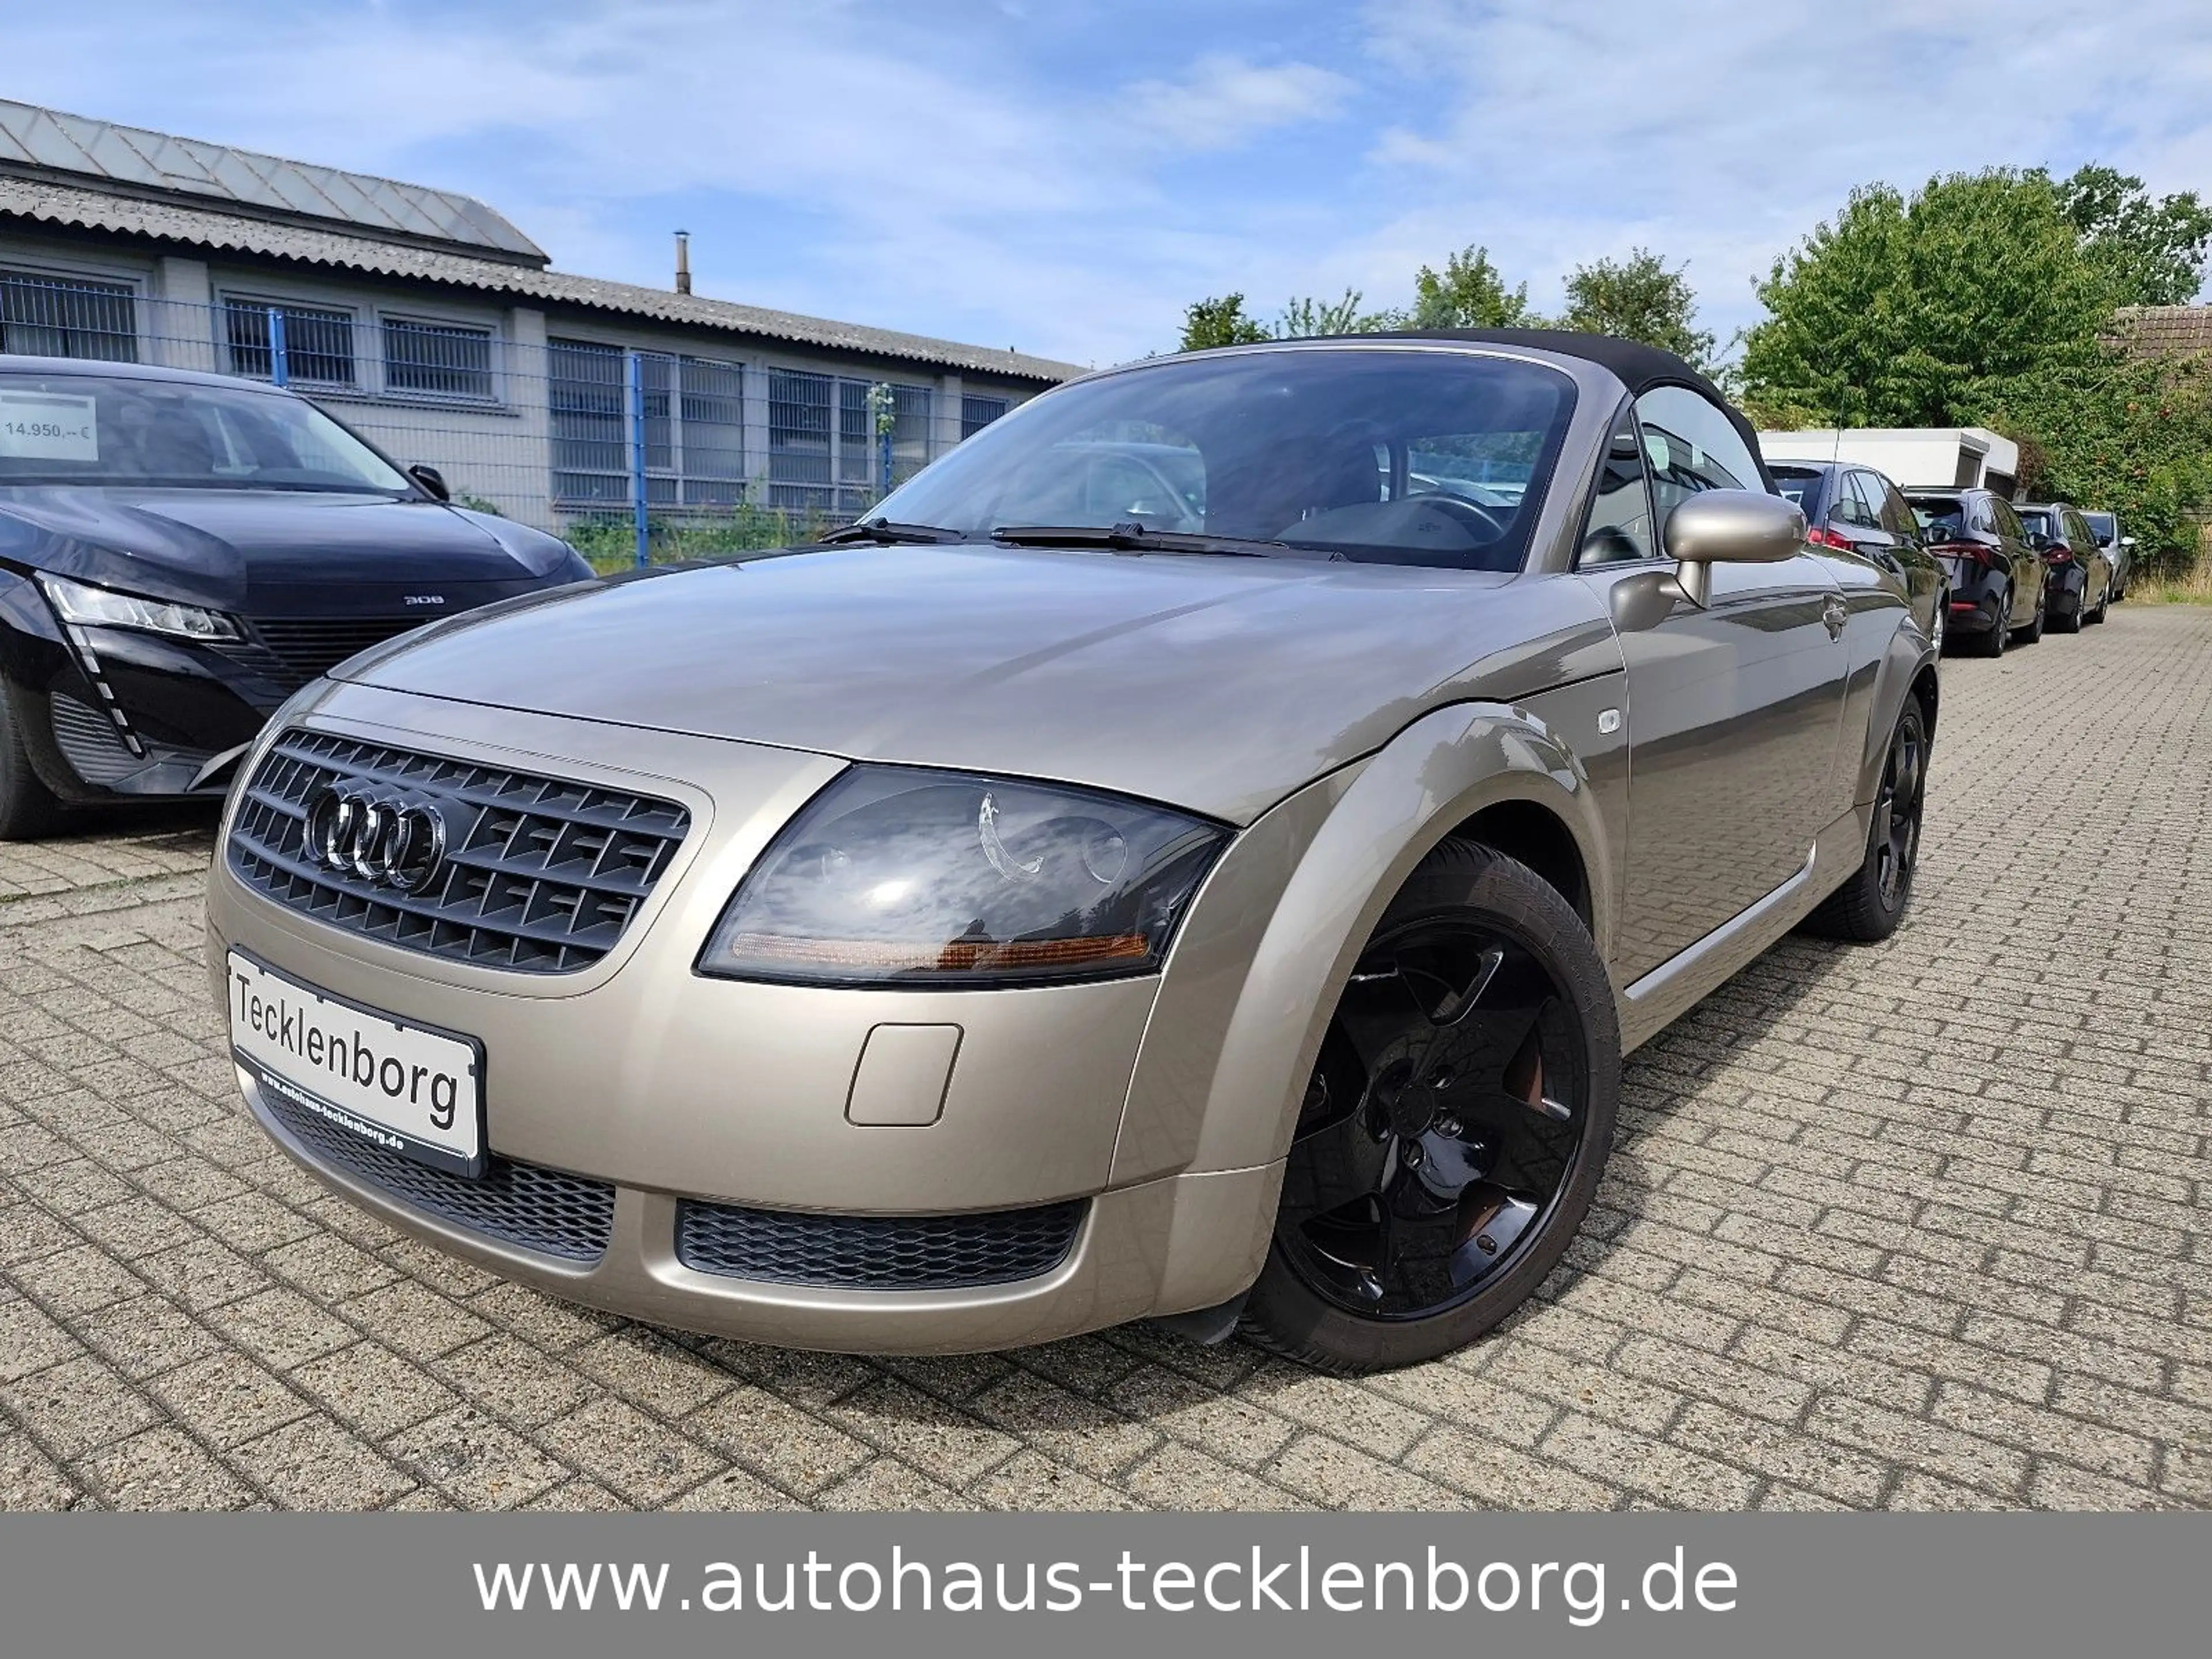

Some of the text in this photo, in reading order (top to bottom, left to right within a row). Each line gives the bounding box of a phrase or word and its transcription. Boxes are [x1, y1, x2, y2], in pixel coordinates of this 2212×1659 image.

[404, 596, 445, 605] 308
[236, 974, 457, 1130] Tecklenborg
[261, 1071, 404, 1150] www.autohaus-tecklenborg.de
